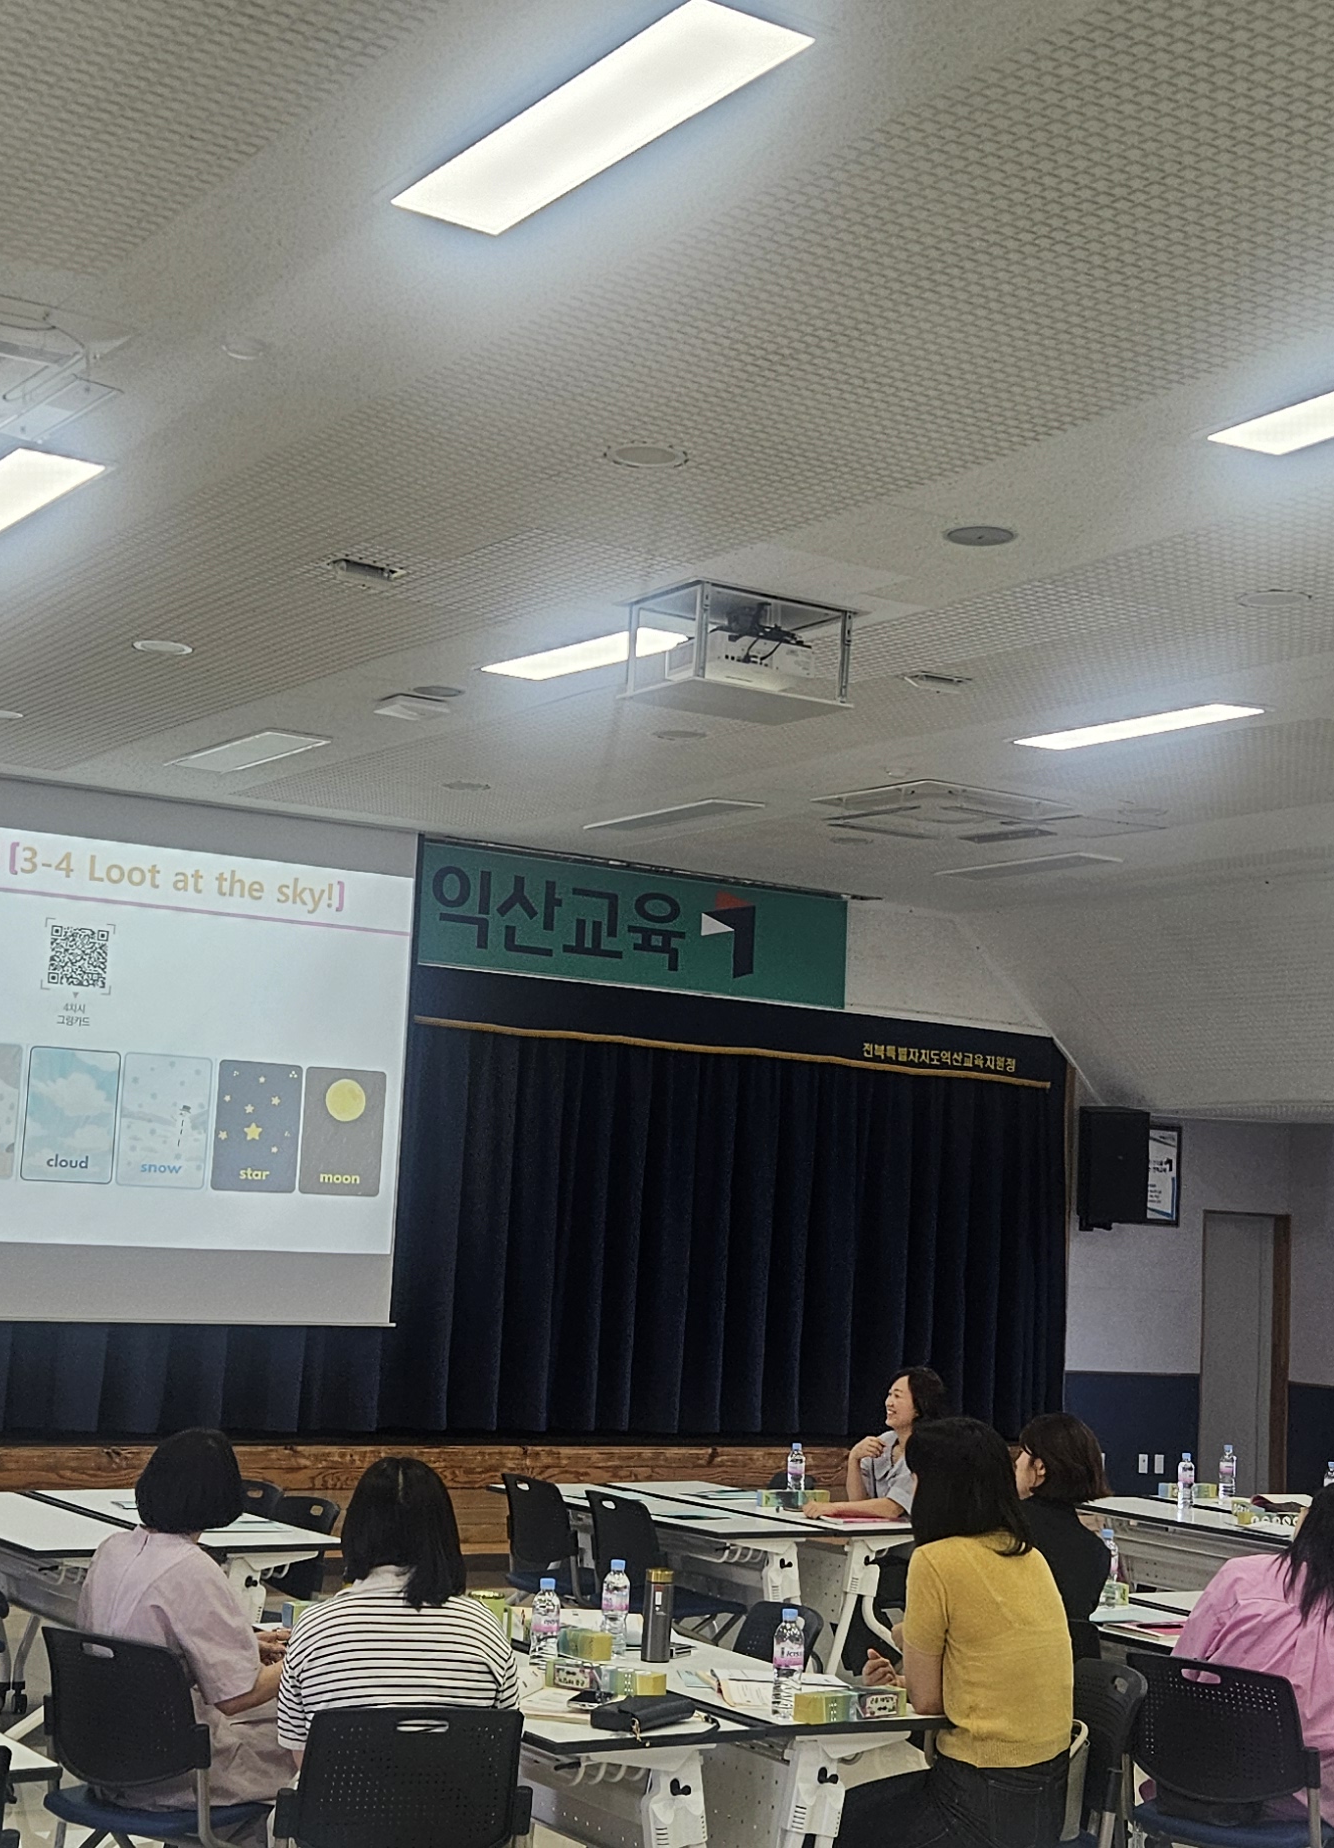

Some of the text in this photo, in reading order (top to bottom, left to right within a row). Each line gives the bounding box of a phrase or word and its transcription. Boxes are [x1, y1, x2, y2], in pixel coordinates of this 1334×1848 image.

[88, 854, 161, 890] Loot
[172, 868, 204, 895] at
[215, 869, 265, 901] the
[431, 865, 686, 972] 익산교육
[46, 1153, 90, 1170] cloud
[140, 1161, 183, 1175] snow
[239, 1166, 271, 1181] star
[319, 1171, 361, 1185] moon
